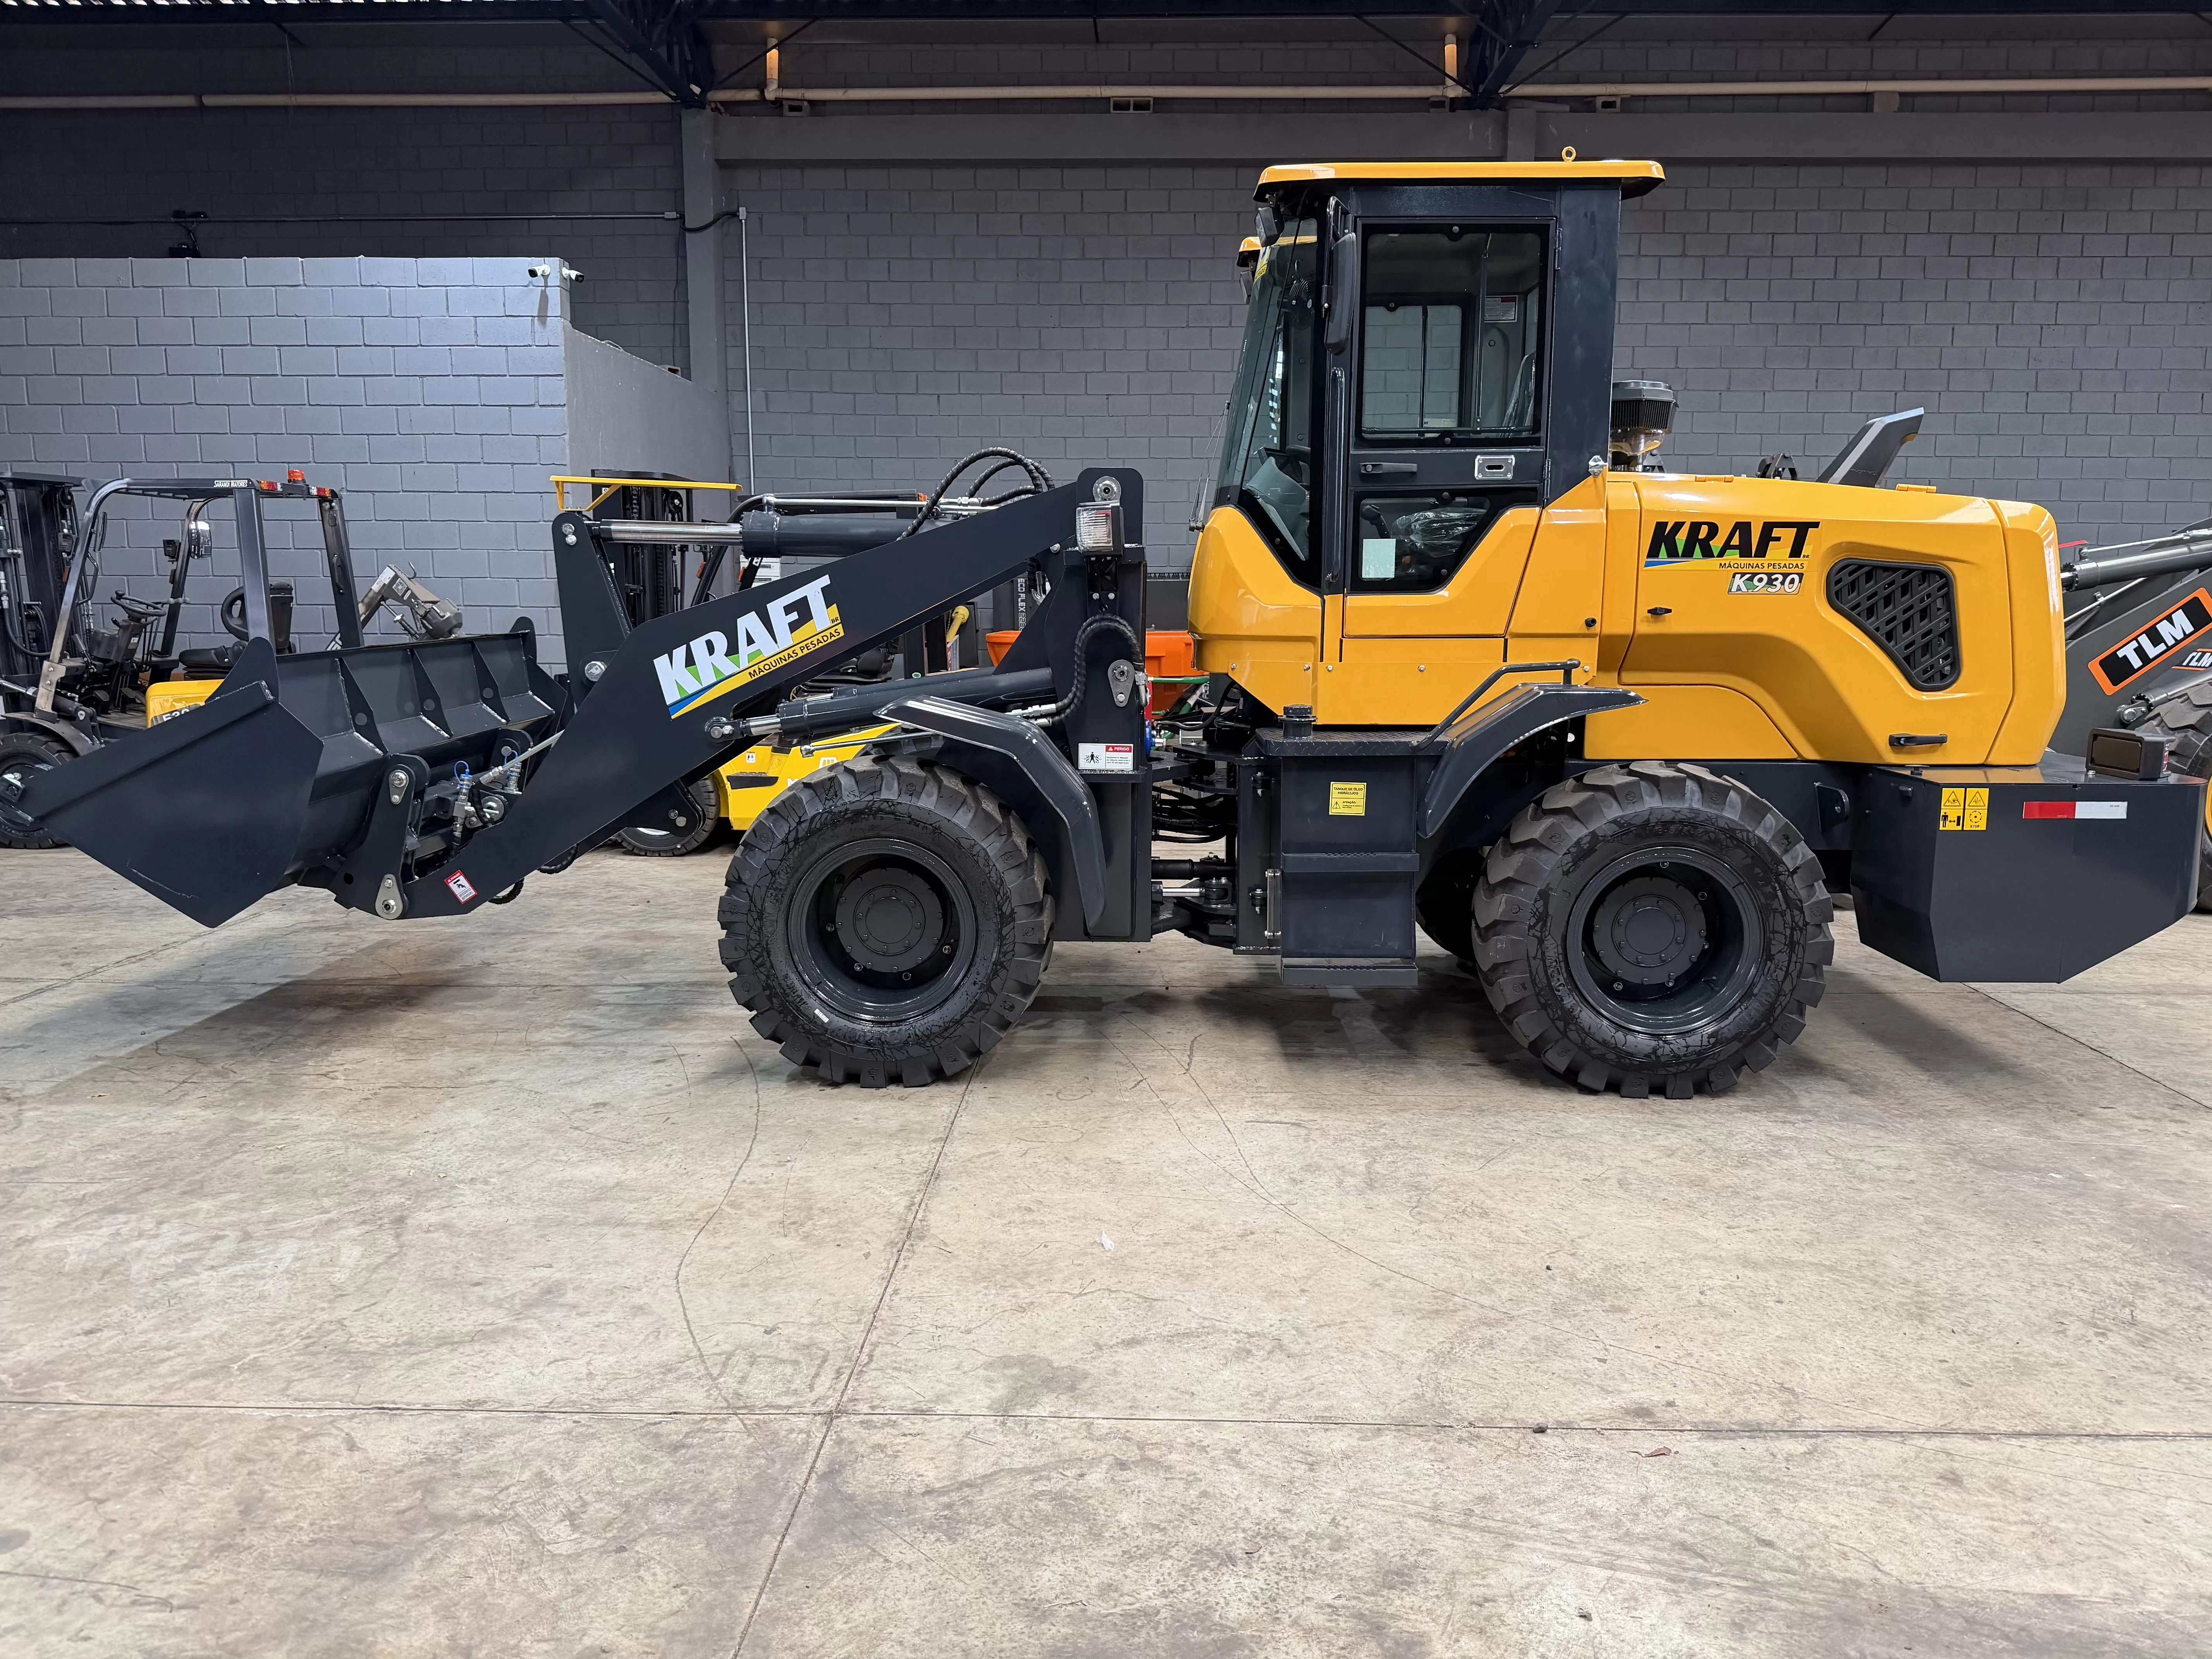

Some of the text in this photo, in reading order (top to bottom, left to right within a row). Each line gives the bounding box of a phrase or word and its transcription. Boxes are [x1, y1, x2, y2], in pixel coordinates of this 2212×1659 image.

[1646, 521, 1820, 558] KRAFT
[1719, 561, 1765, 569] MÁQUINAS
[1730, 573, 1800, 593] K930
[831, 616, 840, 624] BR
[653, 574, 831, 706] KRAFT
[2116, 608, 2195, 670] TLM
[748, 628, 841, 679] MÁQUINAS PESADAS
[2182, 652, 2212, 667] TLM
